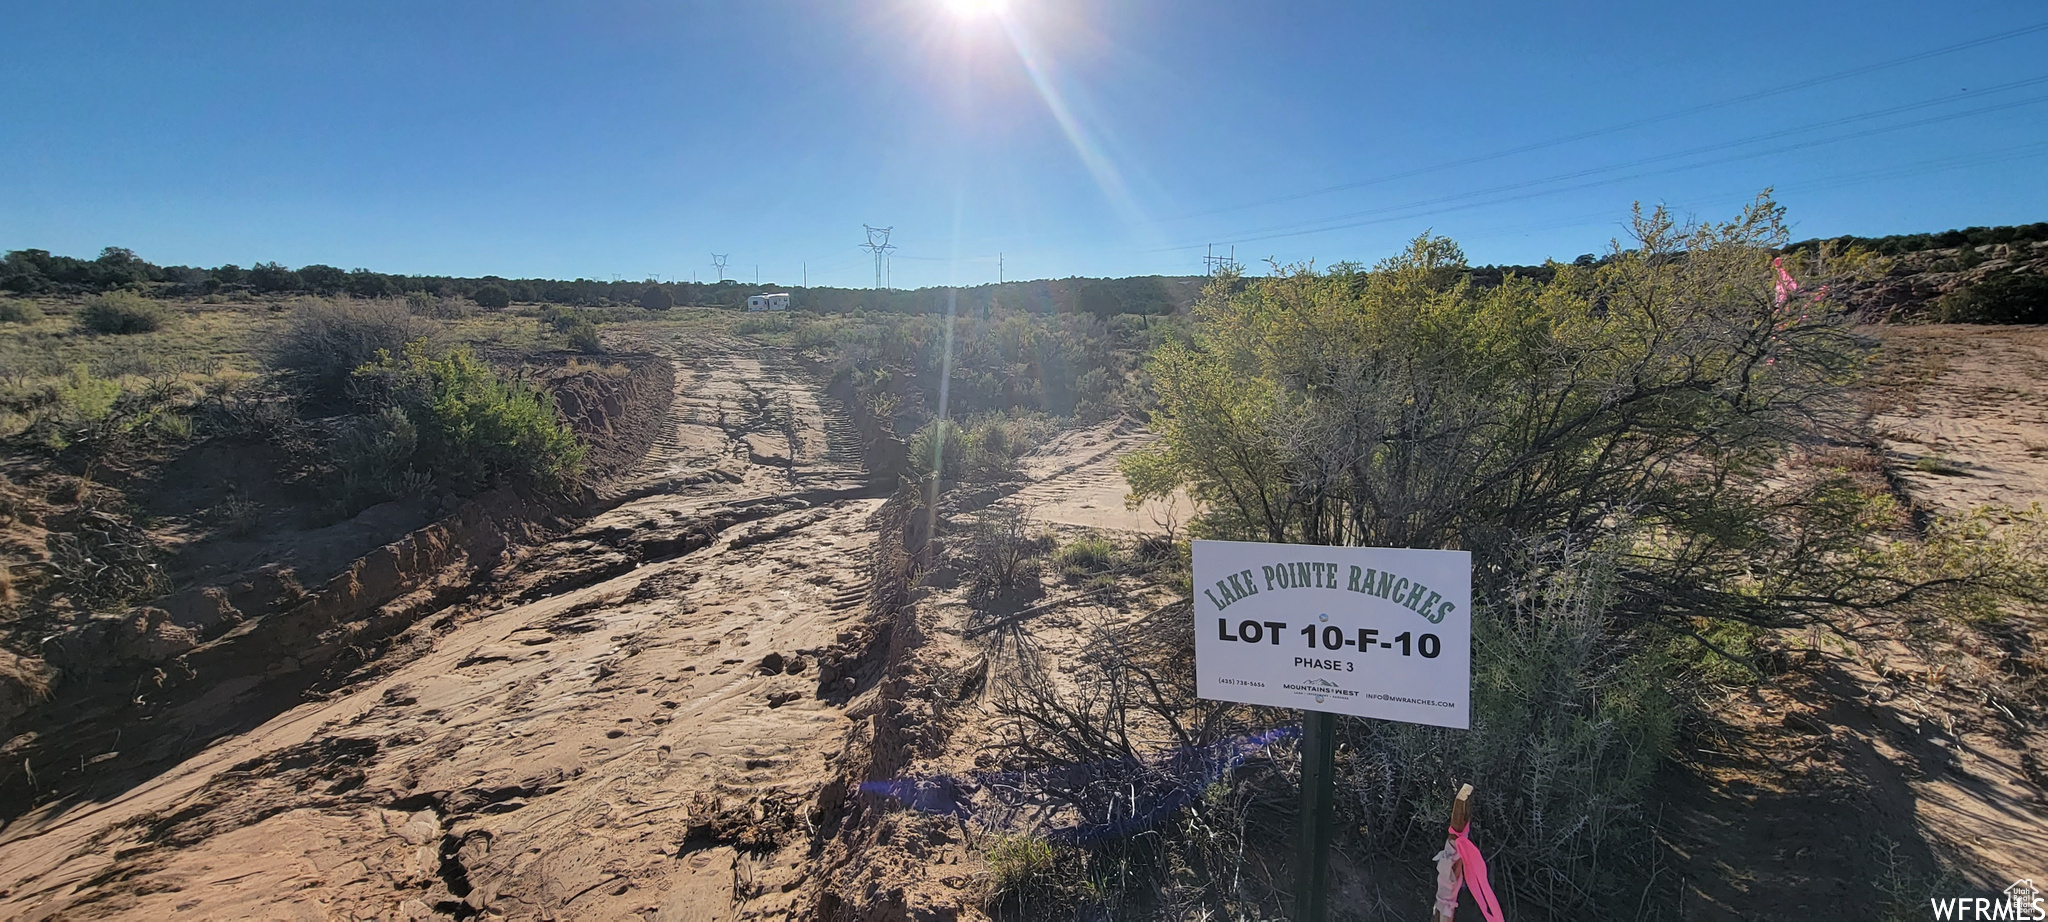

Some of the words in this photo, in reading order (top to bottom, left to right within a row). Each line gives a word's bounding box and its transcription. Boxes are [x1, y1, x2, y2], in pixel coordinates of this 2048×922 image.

[1204, 569, 1259, 611] LAKE
[1261, 562, 1338, 591] POINTE
[1347, 565, 1456, 624] RANCHES
[1218, 618, 1286, 645] LOT
[1300, 624, 1441, 658] 10-F-10
[1294, 657, 1342, 671] PHASE
[1346, 661, 1354, 672] 3
[1218, 677, 1235, 685] (435)
[1283, 684, 1330, 694] MOUNTAINS
[1335, 689, 1360, 697] WEST
[1365, 693, 1455, 708] INFO@MWRANCHES.COM
